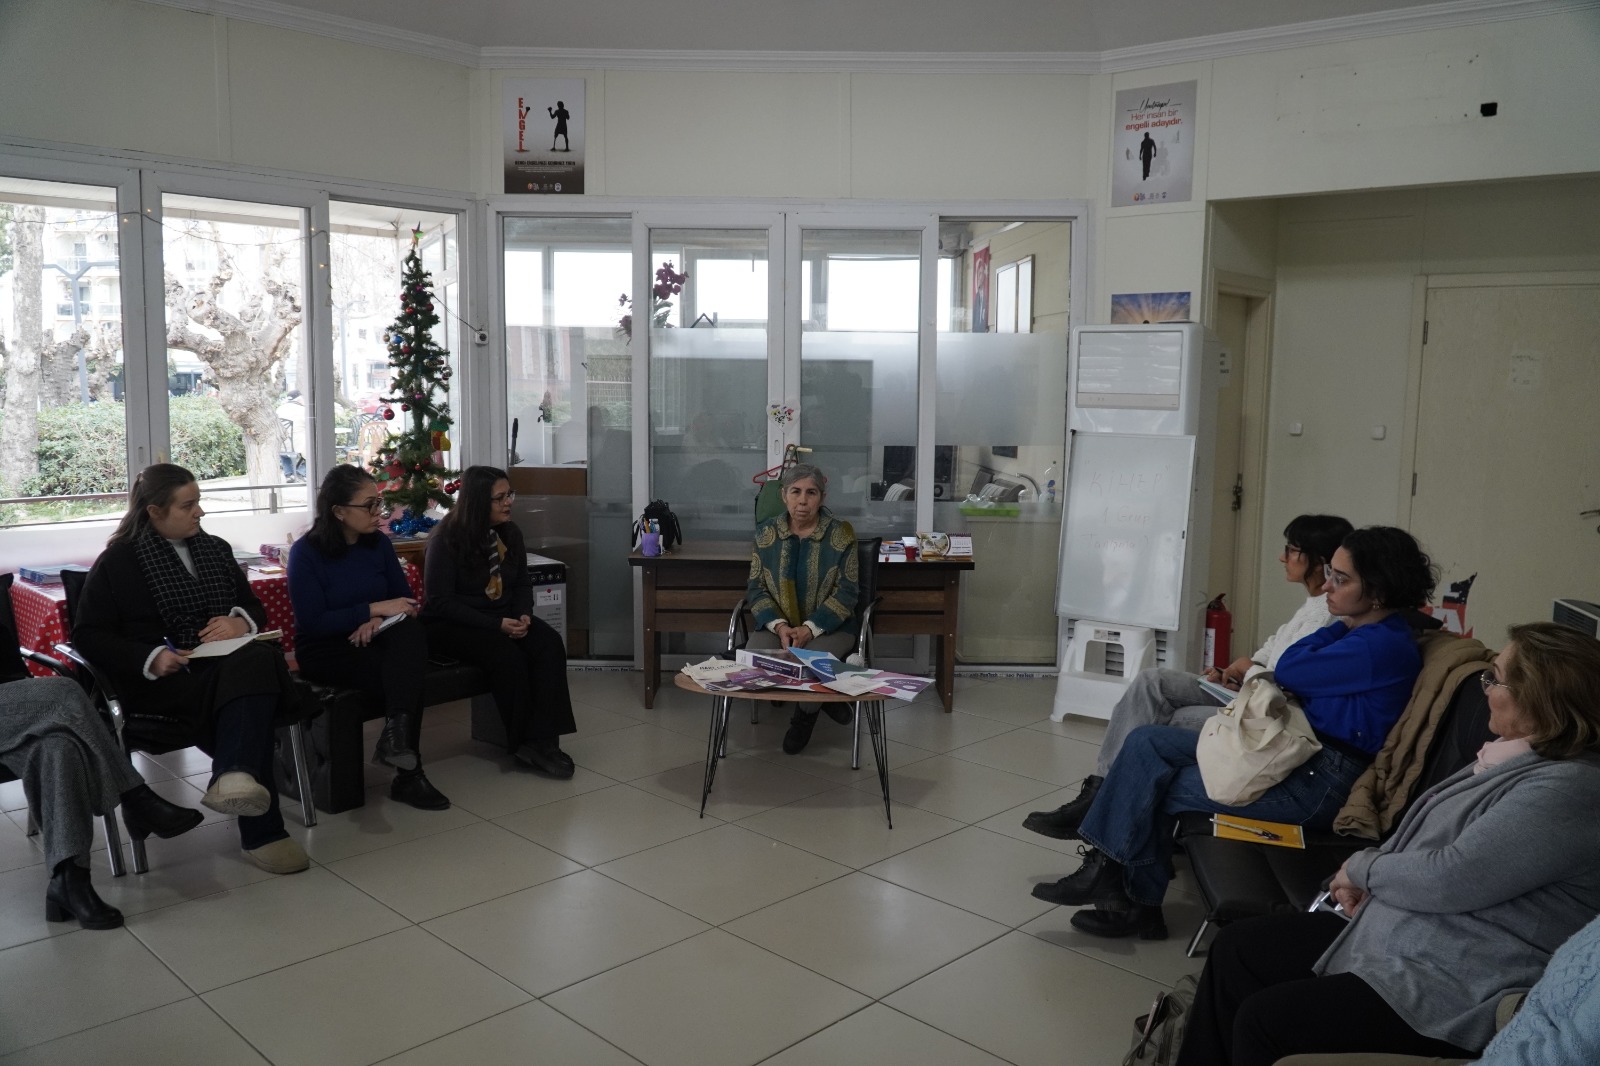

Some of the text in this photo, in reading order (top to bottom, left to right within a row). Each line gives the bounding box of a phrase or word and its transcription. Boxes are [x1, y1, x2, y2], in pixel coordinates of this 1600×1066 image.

[1131, 109, 1178, 121] Her insan bir
[1126, 117, 1183, 131] engelli adayıdır.
